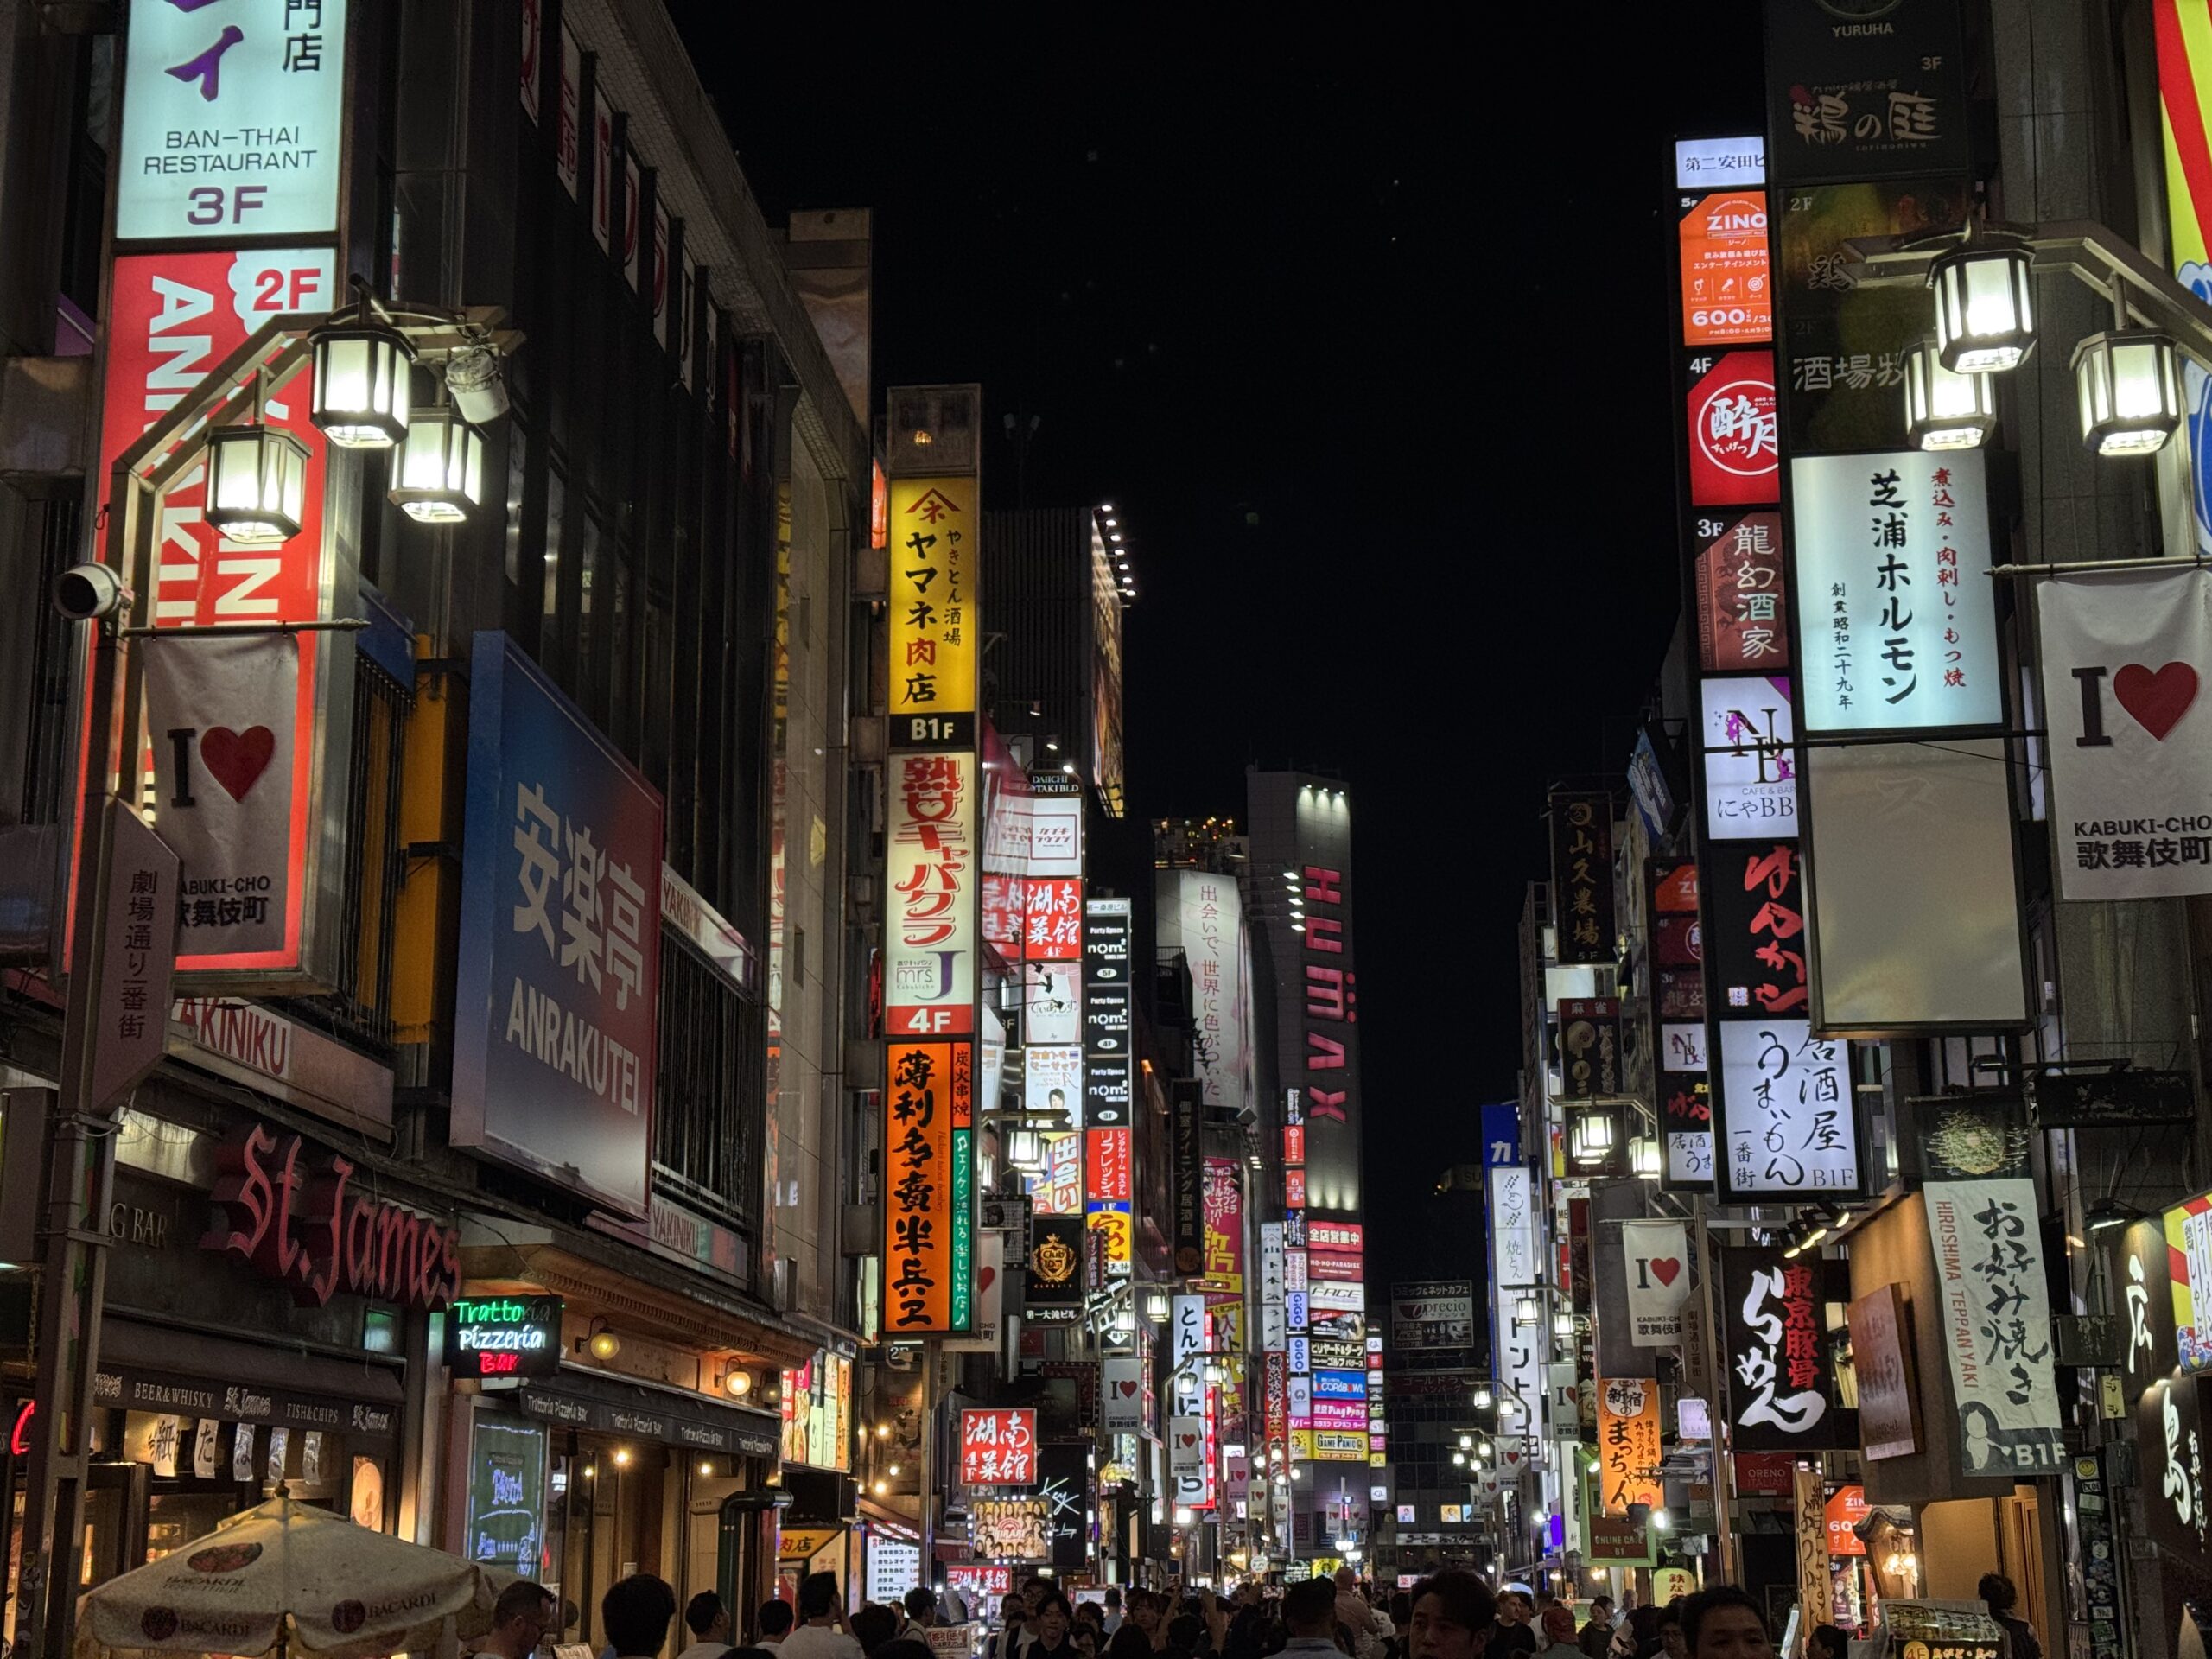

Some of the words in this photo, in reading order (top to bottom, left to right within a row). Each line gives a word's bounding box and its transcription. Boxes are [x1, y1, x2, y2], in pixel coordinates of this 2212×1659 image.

[1832, 22, 1894, 38] YURUHA
[1921, 57, 1942, 70] 3F
[166, 127, 300, 149] BAN-THAI
[143, 150, 318, 175] RESTAURANT
[187, 185, 269, 226] 3F
[1791, 197, 1813, 211] 2F
[252, 270, 321, 312] 2F
[1692, 309, 1745, 326] 600
[1689, 358, 1712, 373] 4F
[1697, 519, 1724, 537] 3F
[942, 529, 963, 647] やきとん酒場
[1733, 524, 1780, 659] 龍幻酒家
[1869, 468, 1917, 705] 芝浦ホルモン
[900, 531, 938, 705] ヤマネ肉店
[1831, 582, 1854, 711] 創業昭和二十九年
[2071, 666, 2113, 747] I
[911, 718, 954, 740] B1F
[167, 728, 197, 808] I
[2074, 814, 2212, 836] KABUKI-CHO
[893, 755, 970, 949] 熟女キャバクラ
[2076, 836, 2212, 870] 歌舞伎町
[180, 874, 270, 896] ABUKI-CHO
[512, 781, 645, 1012] 安楽亭
[1027, 883, 1080, 915] 湖南
[1027, 916, 1080, 945] 菜館
[118, 869, 158, 1039] 劇場通り一番街
[1043, 946, 1063, 957] 4F
[1578, 952, 1599, 962] 5F
[907, 1007, 951, 1033] 4F
[1571, 1001, 1608, 1015] 麻雀
[505, 976, 639, 1116] ANRAKUTEI
[953, 1051, 970, 1117] 炭火串焼
[1796, 1025, 1847, 1151] 居酒屋
[1752, 1031, 1806, 1186] うまいもん
[1053, 1134, 1079, 1213] 出会い
[1100, 1130, 1114, 1198] リフレッシュ
[1733, 1129, 1758, 1189] 一番街
[1813, 1168, 1854, 1187] B1F
[1103, 1201, 1117, 1210] 1F
[131, 1207, 168, 1249] BAR
[652, 1202, 699, 1258] YAKINIKU
[1309, 1228, 1360, 1246] 全店営業中
[1635, 1258, 1652, 1289] I
[1293, 1294, 1303, 1325] GiGO
[1936, 1200, 1962, 1281] HIROSHIMA
[1952, 1290, 1980, 1389] TEPPANYAKI
[1783, 1263, 1820, 1389] 東京豚骨
[480, 1352, 520, 1374] Bar
[1294, 1338, 1304, 1370] GiGO
[1311, 1344, 1364, 1357] ビリヤード&ダーツ
[134, 1382, 214, 1409] BEER&WHISKY
[1111, 1381, 1119, 1400] I
[285, 1402, 340, 1423] FISH&CHIPS
[965, 1410, 1031, 1448] 湖南
[1317, 1434, 1335, 1448] GAME
[1337, 1434, 1356, 1449] PANIC
[978, 1449, 1030, 1483] 菜館
[2014, 1443, 2066, 1466] B1F
[1747, 1469, 1786, 1478] ORENO
[1748, 1478, 1788, 1488] ITALIAN
[369, 1592, 435, 1618] BACARDI
[180, 1619, 251, 1637] BACARDI
